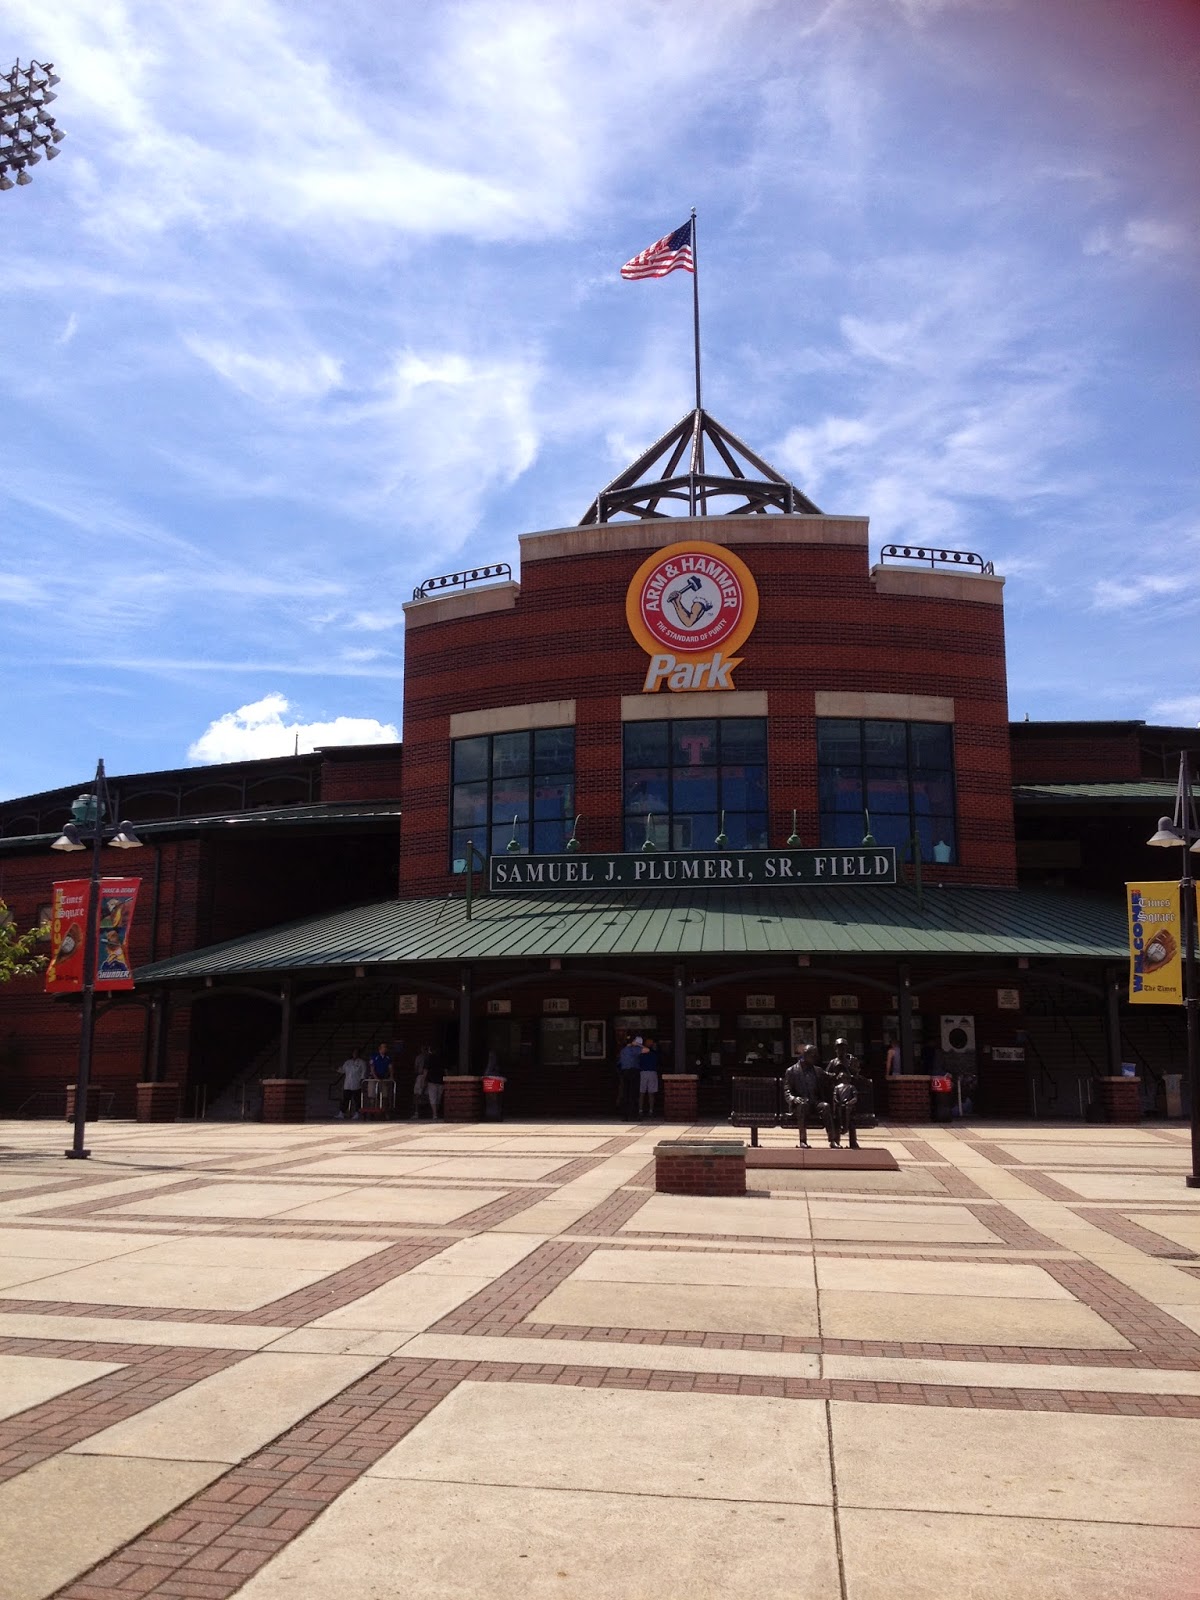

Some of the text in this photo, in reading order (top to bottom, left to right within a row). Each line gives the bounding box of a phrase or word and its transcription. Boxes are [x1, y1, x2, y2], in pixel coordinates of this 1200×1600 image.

[646, 557, 738, 612] ARM & HAMMER
[656, 618, 727, 642] THE STANDARD OF PURITY
[645, 652, 733, 690] Park
[496, 855, 889, 883] SAMUEL J. PLUMERI, SR. FIELD
[60, 895, 84, 905] Times
[1138, 897, 1171, 908] Times
[58, 908, 85, 919] Square
[1136, 911, 1175, 923] Square
[1157, 985, 1177, 993] Times
